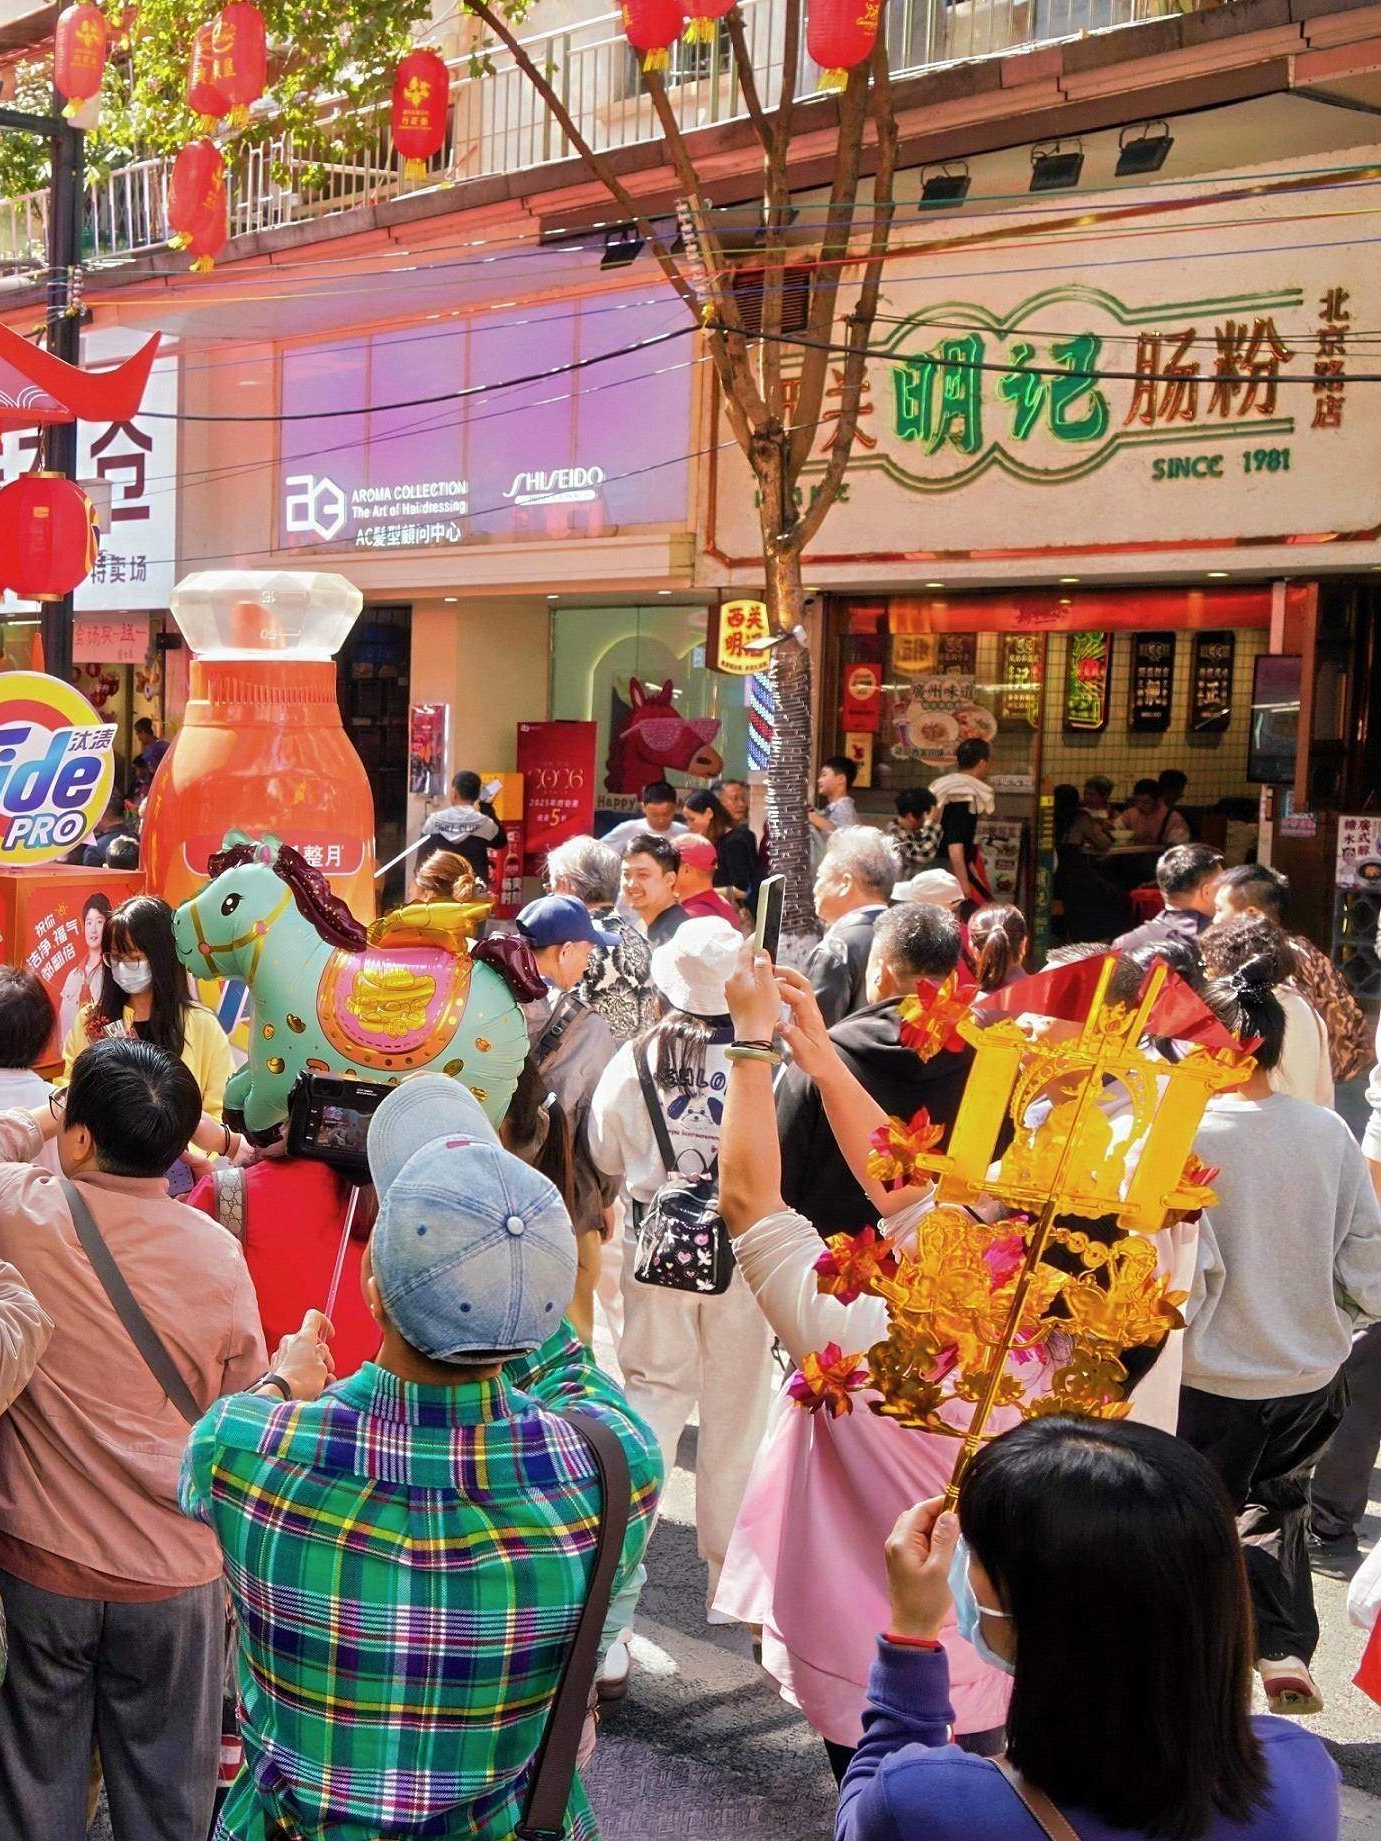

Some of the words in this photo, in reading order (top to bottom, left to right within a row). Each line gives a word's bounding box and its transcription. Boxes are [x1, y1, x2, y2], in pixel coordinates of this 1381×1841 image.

[1243, 448, 1290, 473] 1981
[351, 487, 391, 503] AROMA
[393, 480, 466, 500] COLLECTION
[503, 465, 605, 499] SHISEIDO
[352, 505, 369, 518] The
[372, 504, 387, 517] Art
[389, 502, 400, 516] of
[403, 500, 466, 516] Hairdressing
[68, 728, 113, 752] 汰渍
[597, 795, 637, 811] Happy
[2, 810, 87, 850] PRO
